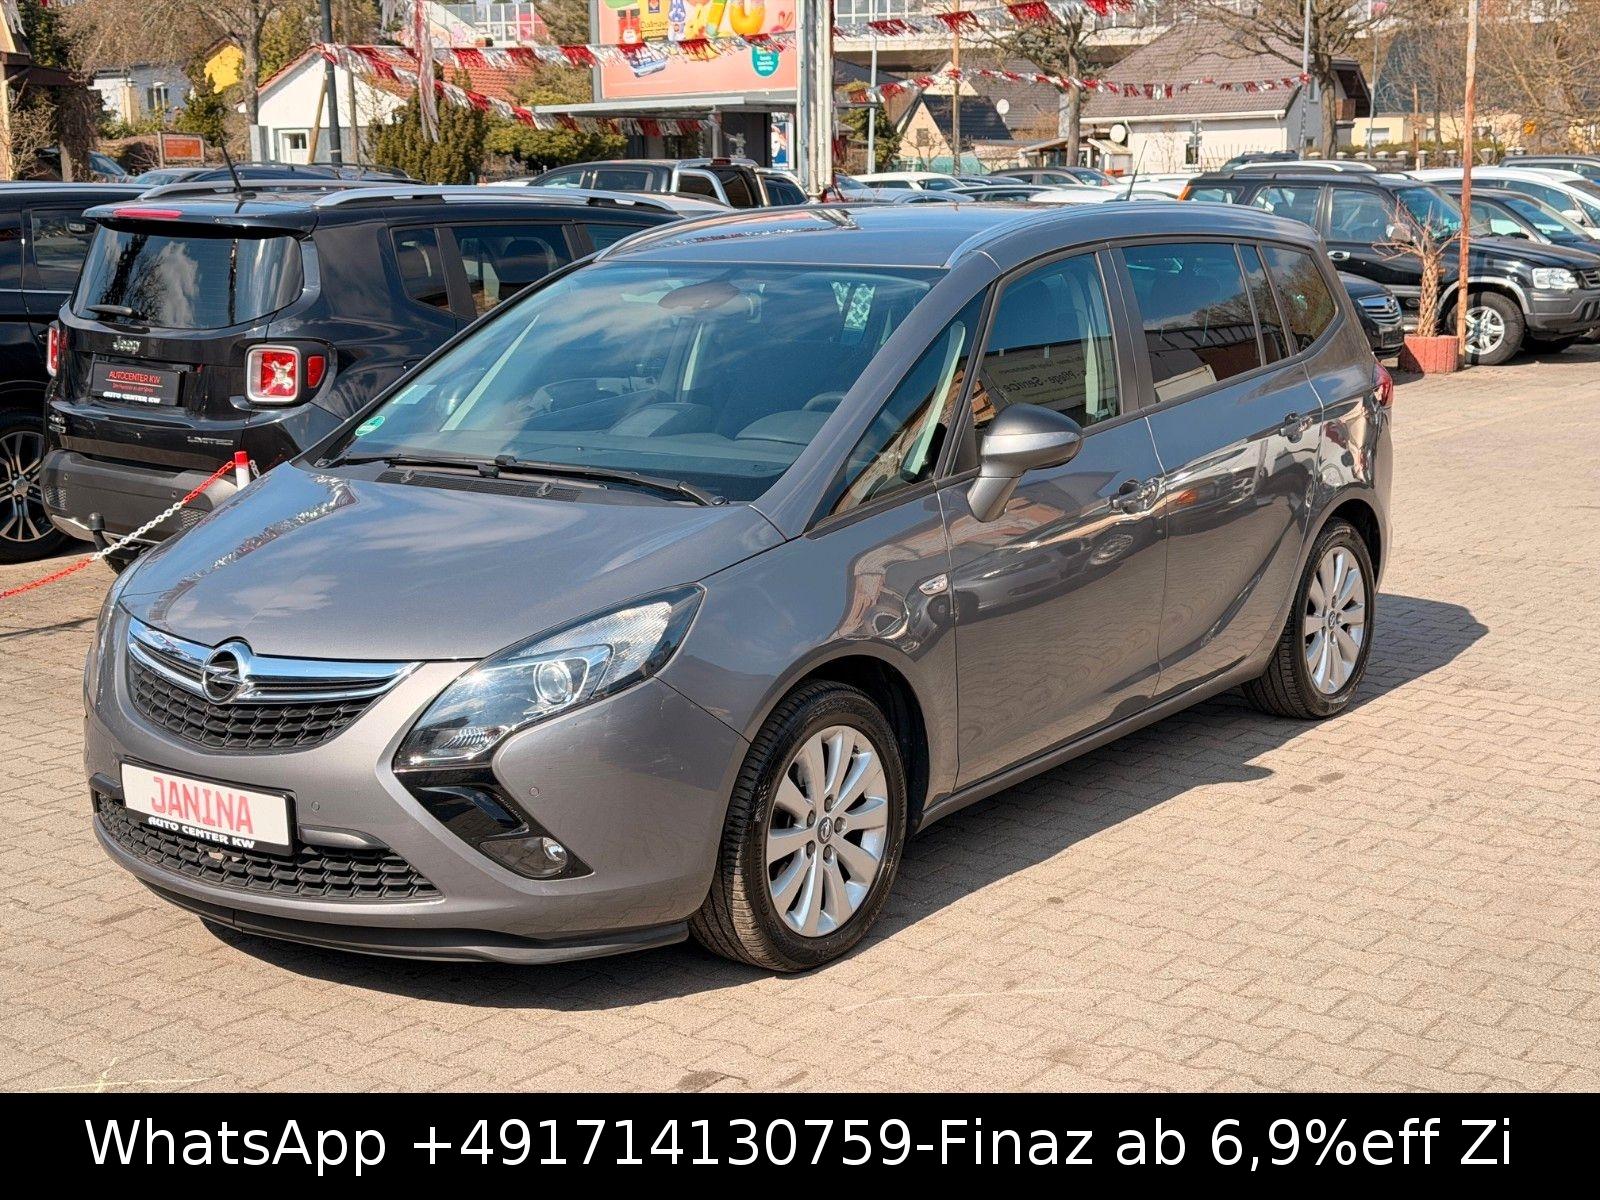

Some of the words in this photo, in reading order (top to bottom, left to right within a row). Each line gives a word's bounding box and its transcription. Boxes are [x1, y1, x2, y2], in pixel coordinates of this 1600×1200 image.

[112, 335, 141, 355] Jeep
[108, 370, 148, 383] AUTOCENTER
[149, 374, 161, 384] KW
[103, 391, 122, 399] AUTO
[122, 392, 148, 403] CENTER
[151, 776, 254, 834] JANINA
[148, 816, 179, 832] AUTO
[181, 824, 229, 845] CENTER
[231, 836, 256, 849] KW
